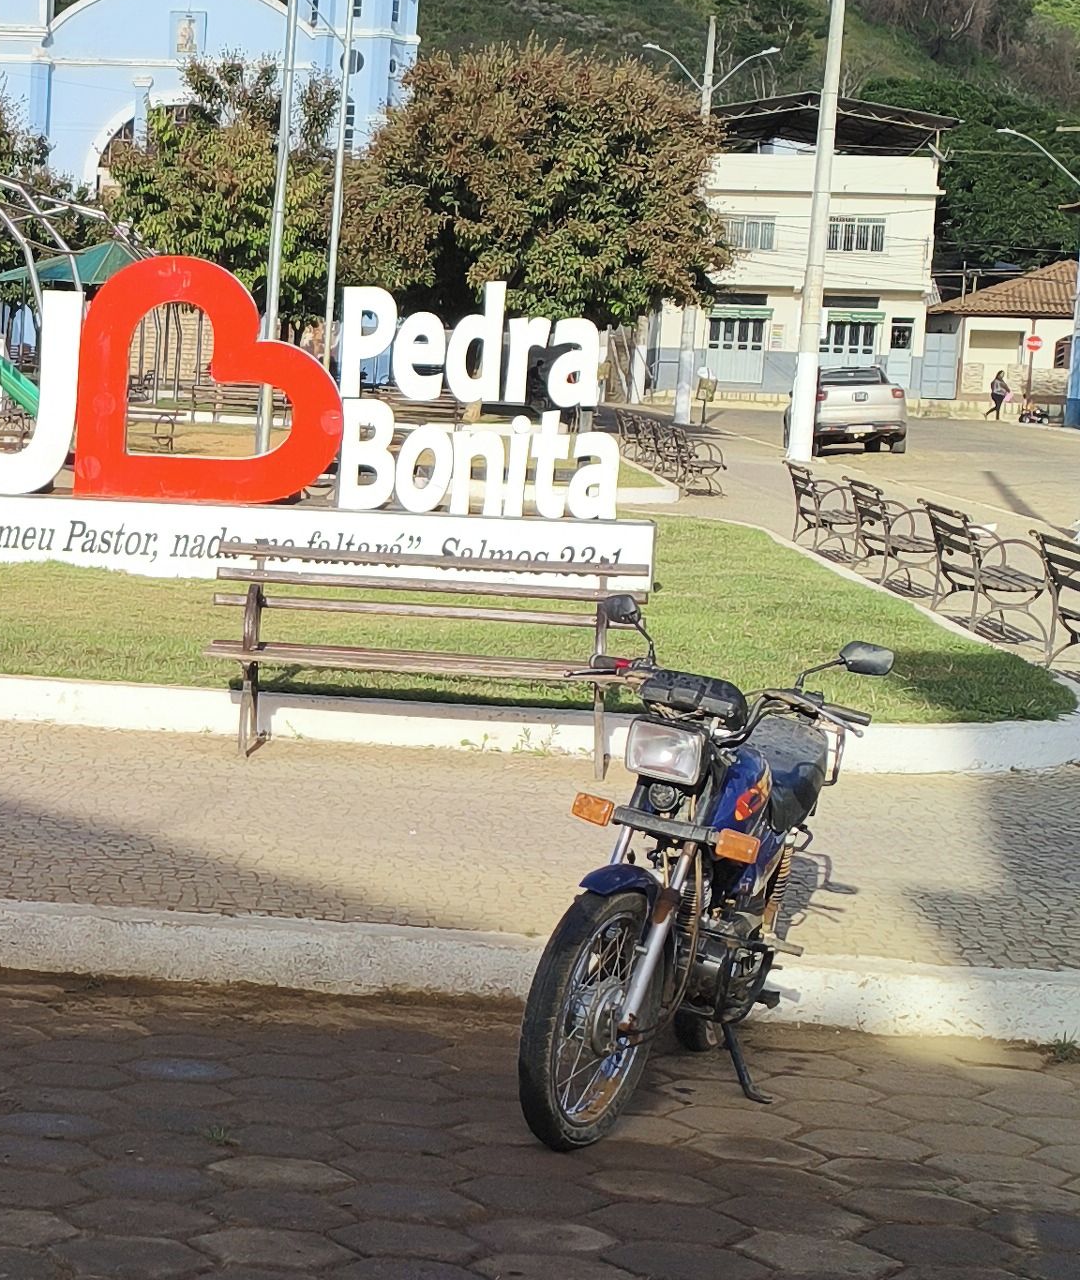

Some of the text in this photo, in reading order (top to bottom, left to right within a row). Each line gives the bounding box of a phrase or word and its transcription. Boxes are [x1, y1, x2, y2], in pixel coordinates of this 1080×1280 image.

[339, 281, 600, 408] Pedra
[338, 398, 620, 520] Bonita
[62, 520, 159, 564] Pastor,
[557, 546, 623, 578] 231
